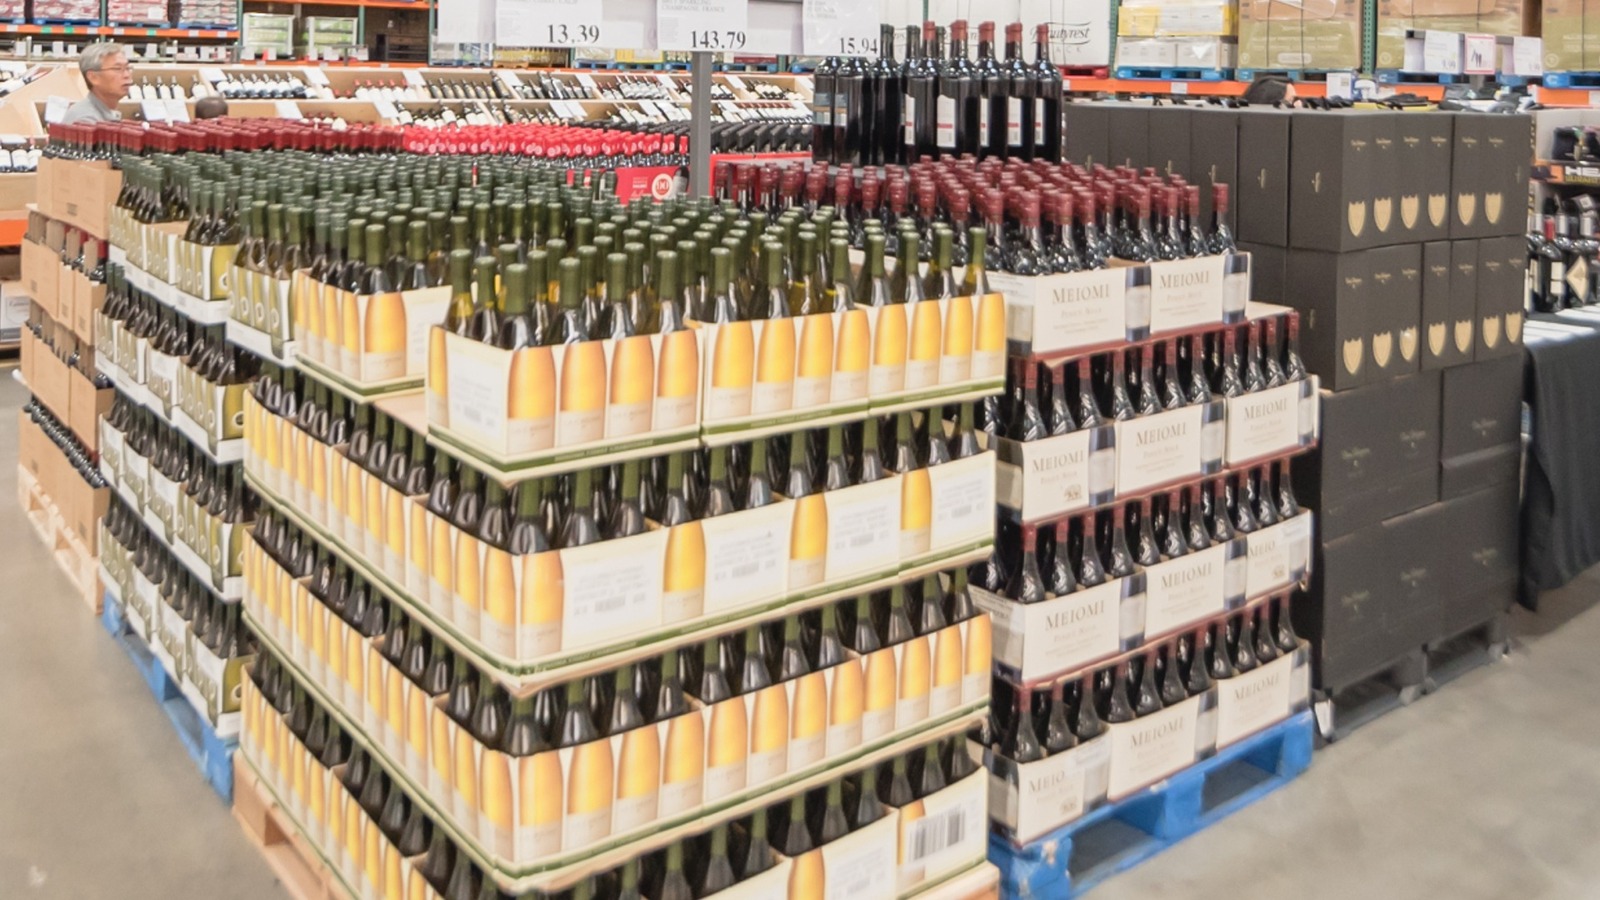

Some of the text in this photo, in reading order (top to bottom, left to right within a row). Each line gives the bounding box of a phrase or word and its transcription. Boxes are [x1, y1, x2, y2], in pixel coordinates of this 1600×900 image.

[547, 24, 600, 44] 13.39
[690, 30, 746, 49] 143.79
[840, 37, 878, 54] 15.94
[1160, 270, 1209, 290] MEIOMI
[1052, 283, 1110, 304] MEIOMI
[1244, 398, 1287, 421] MEIOMI
[1135, 422, 1187, 447] MEIOMI
[1032, 450, 1084, 474] MEIOMI
[1249, 540, 1276, 558] MEIO
[1160, 562, 1213, 589] MEIOMI
[1044, 599, 1105, 632] MEIOMI
[1232, 671, 1280, 701] MEIOMI
[1130, 715, 1185, 749] MEIOMI
[1028, 769, 1065, 795] MEIO
